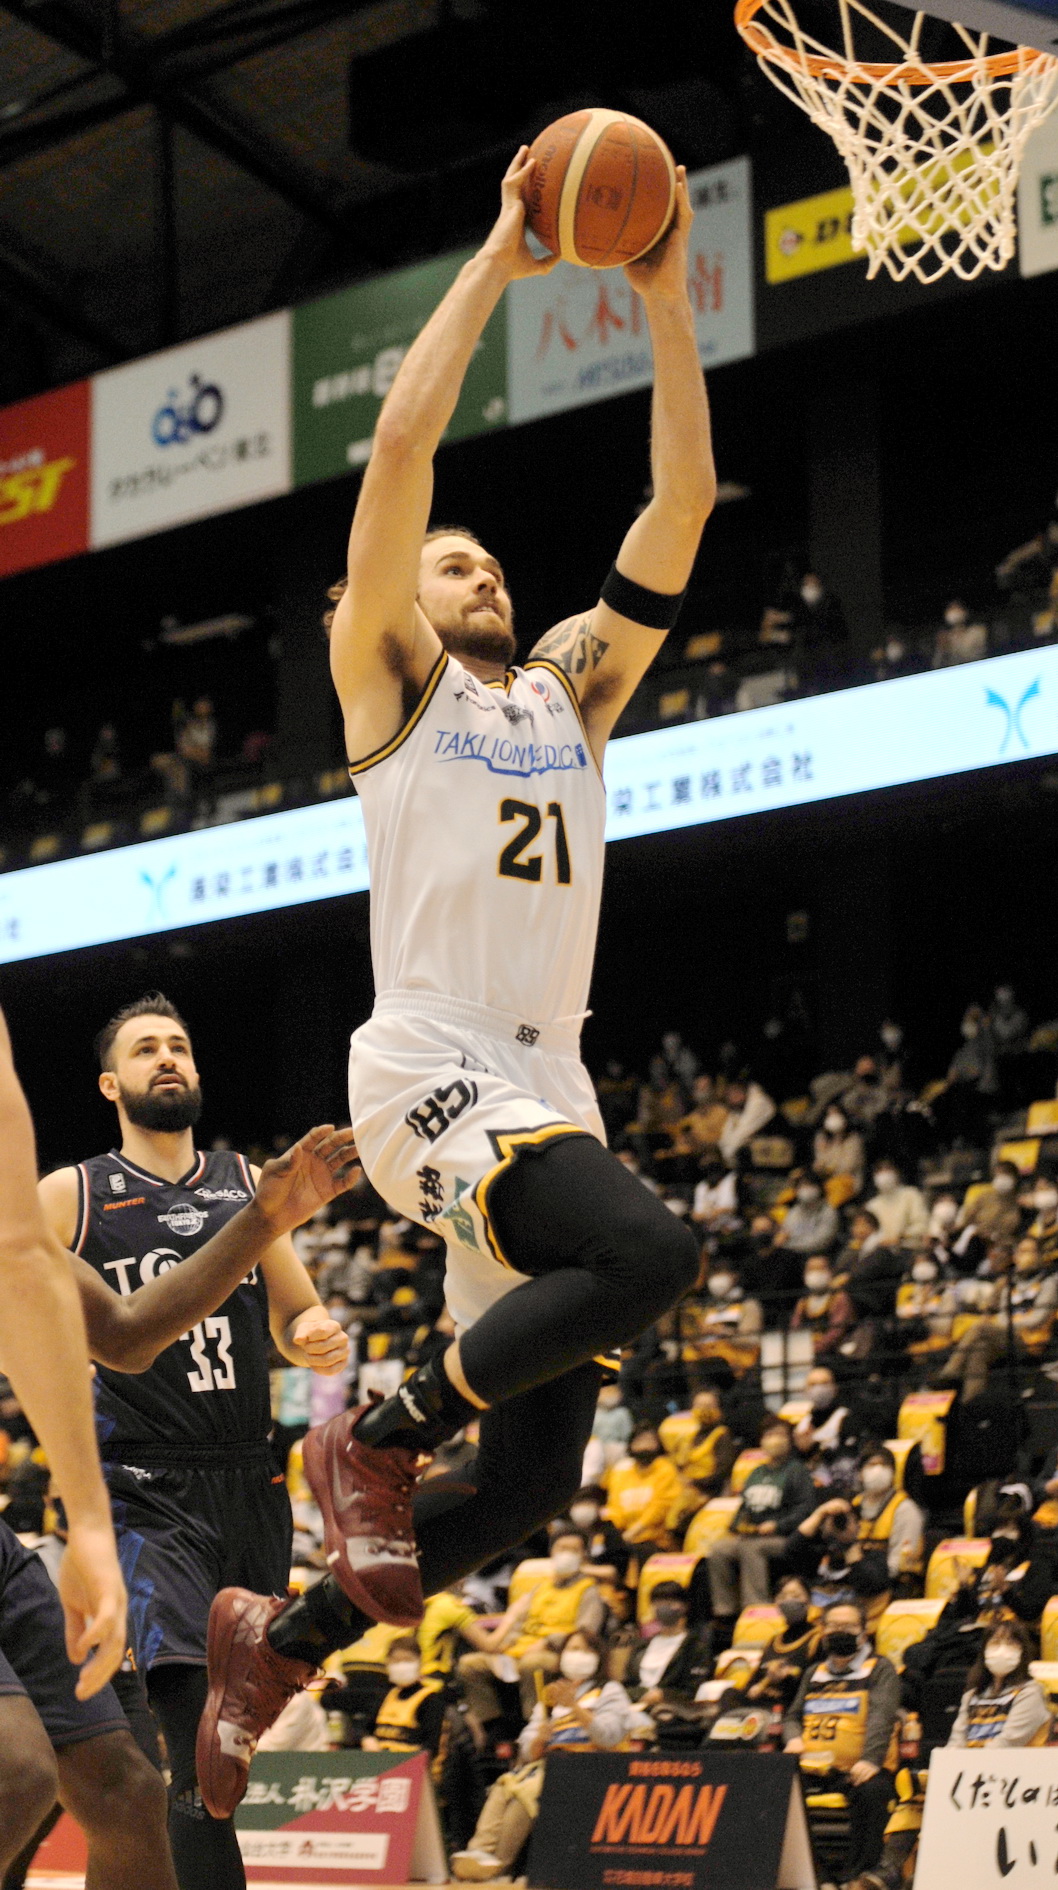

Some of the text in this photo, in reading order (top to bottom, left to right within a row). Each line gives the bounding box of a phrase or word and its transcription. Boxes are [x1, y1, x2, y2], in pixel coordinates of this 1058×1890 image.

[497, 797, 572, 887] 21
[179, 1315, 237, 1393] 33
[591, 1783, 728, 1845] KADAN
